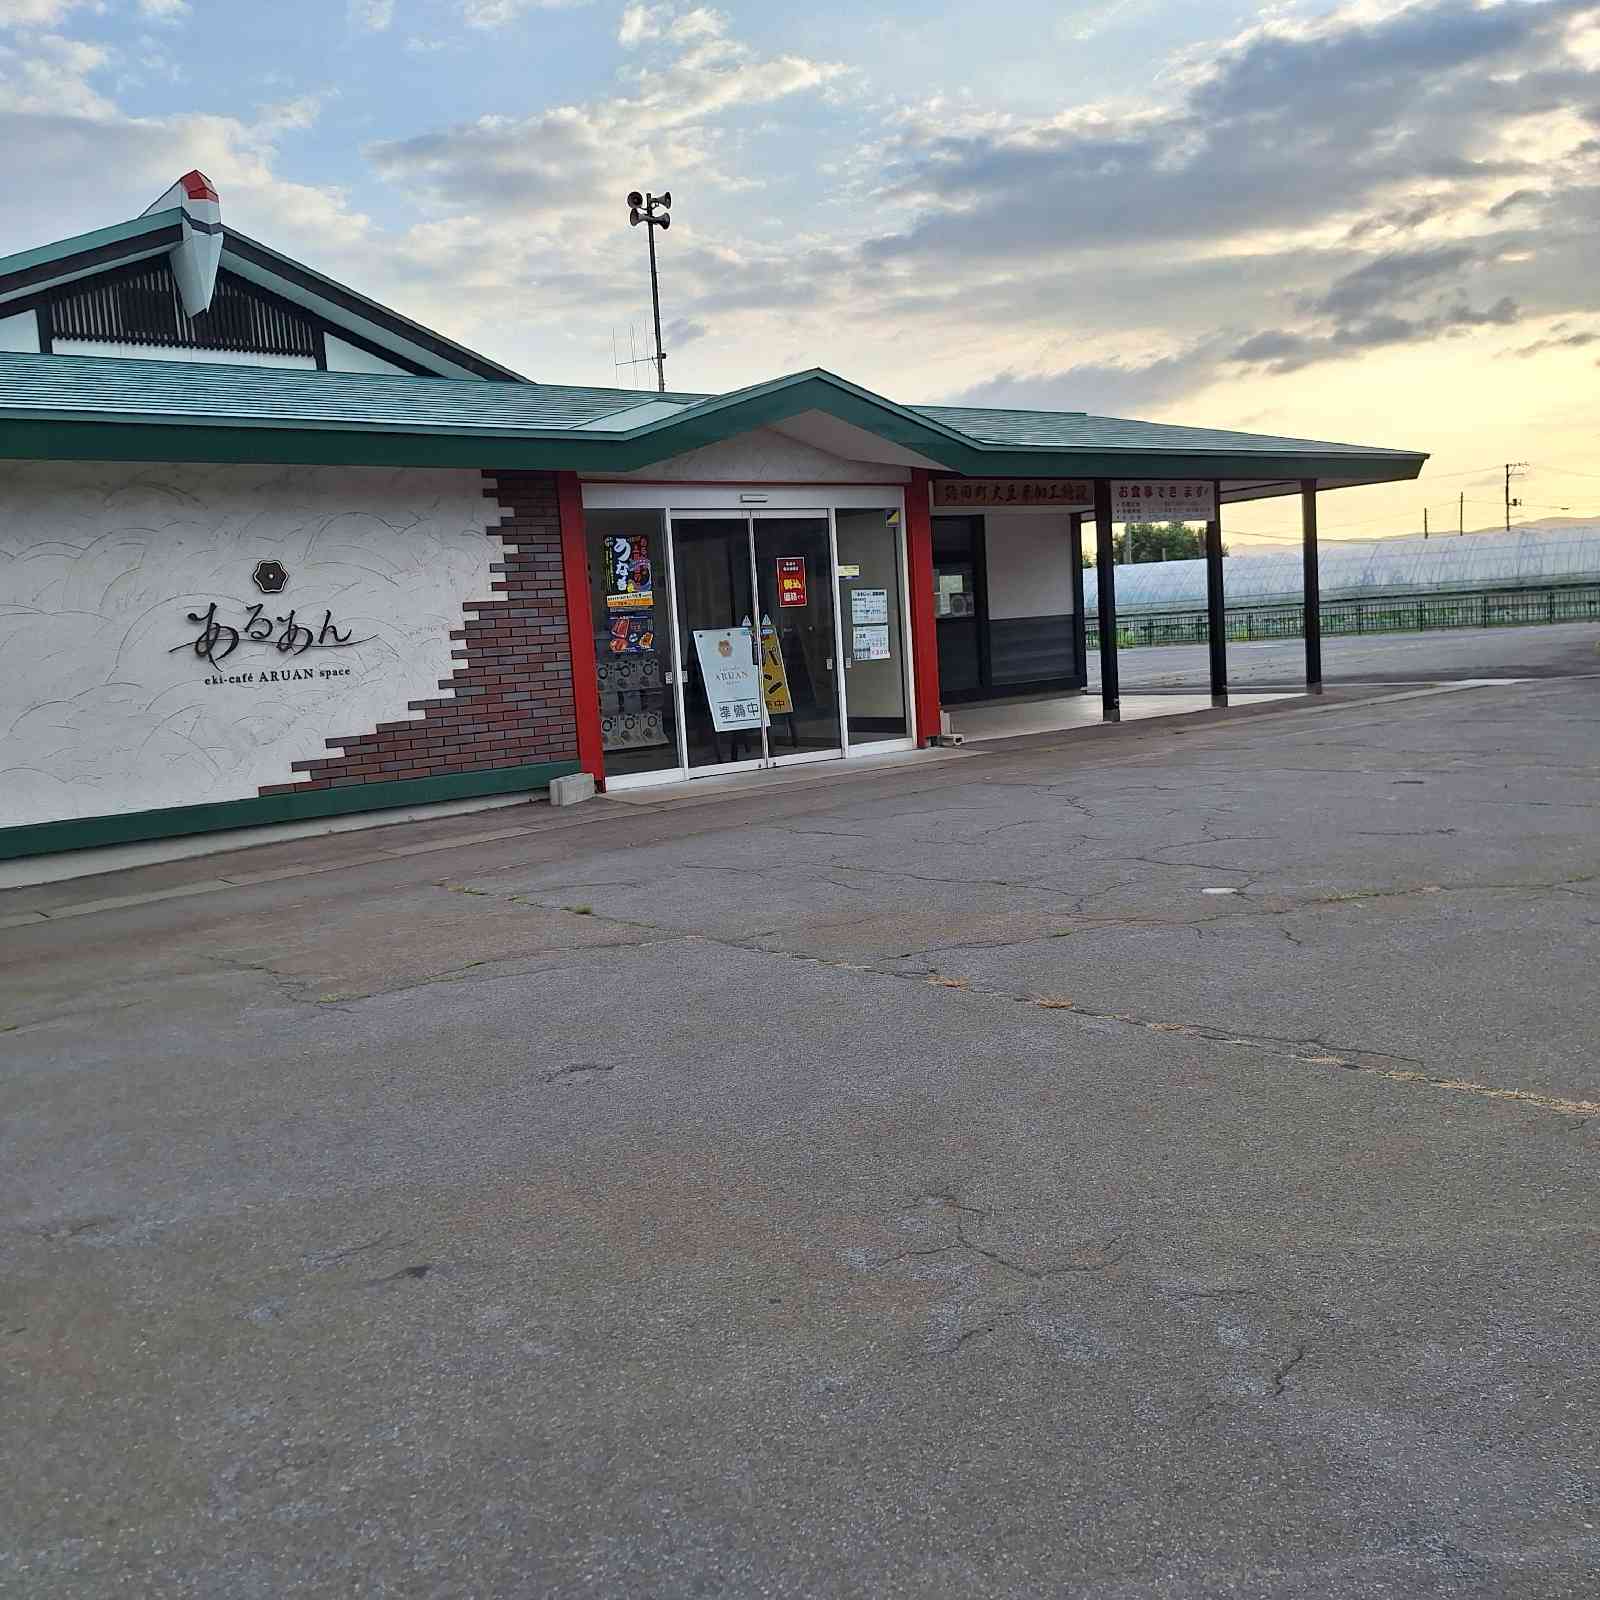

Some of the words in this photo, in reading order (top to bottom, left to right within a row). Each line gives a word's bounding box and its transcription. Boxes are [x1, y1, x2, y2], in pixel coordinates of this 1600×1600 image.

[178, 602, 364, 672] あるあん
[259, 668, 313, 683] ARUAN
[319, 668, 351, 681] space
